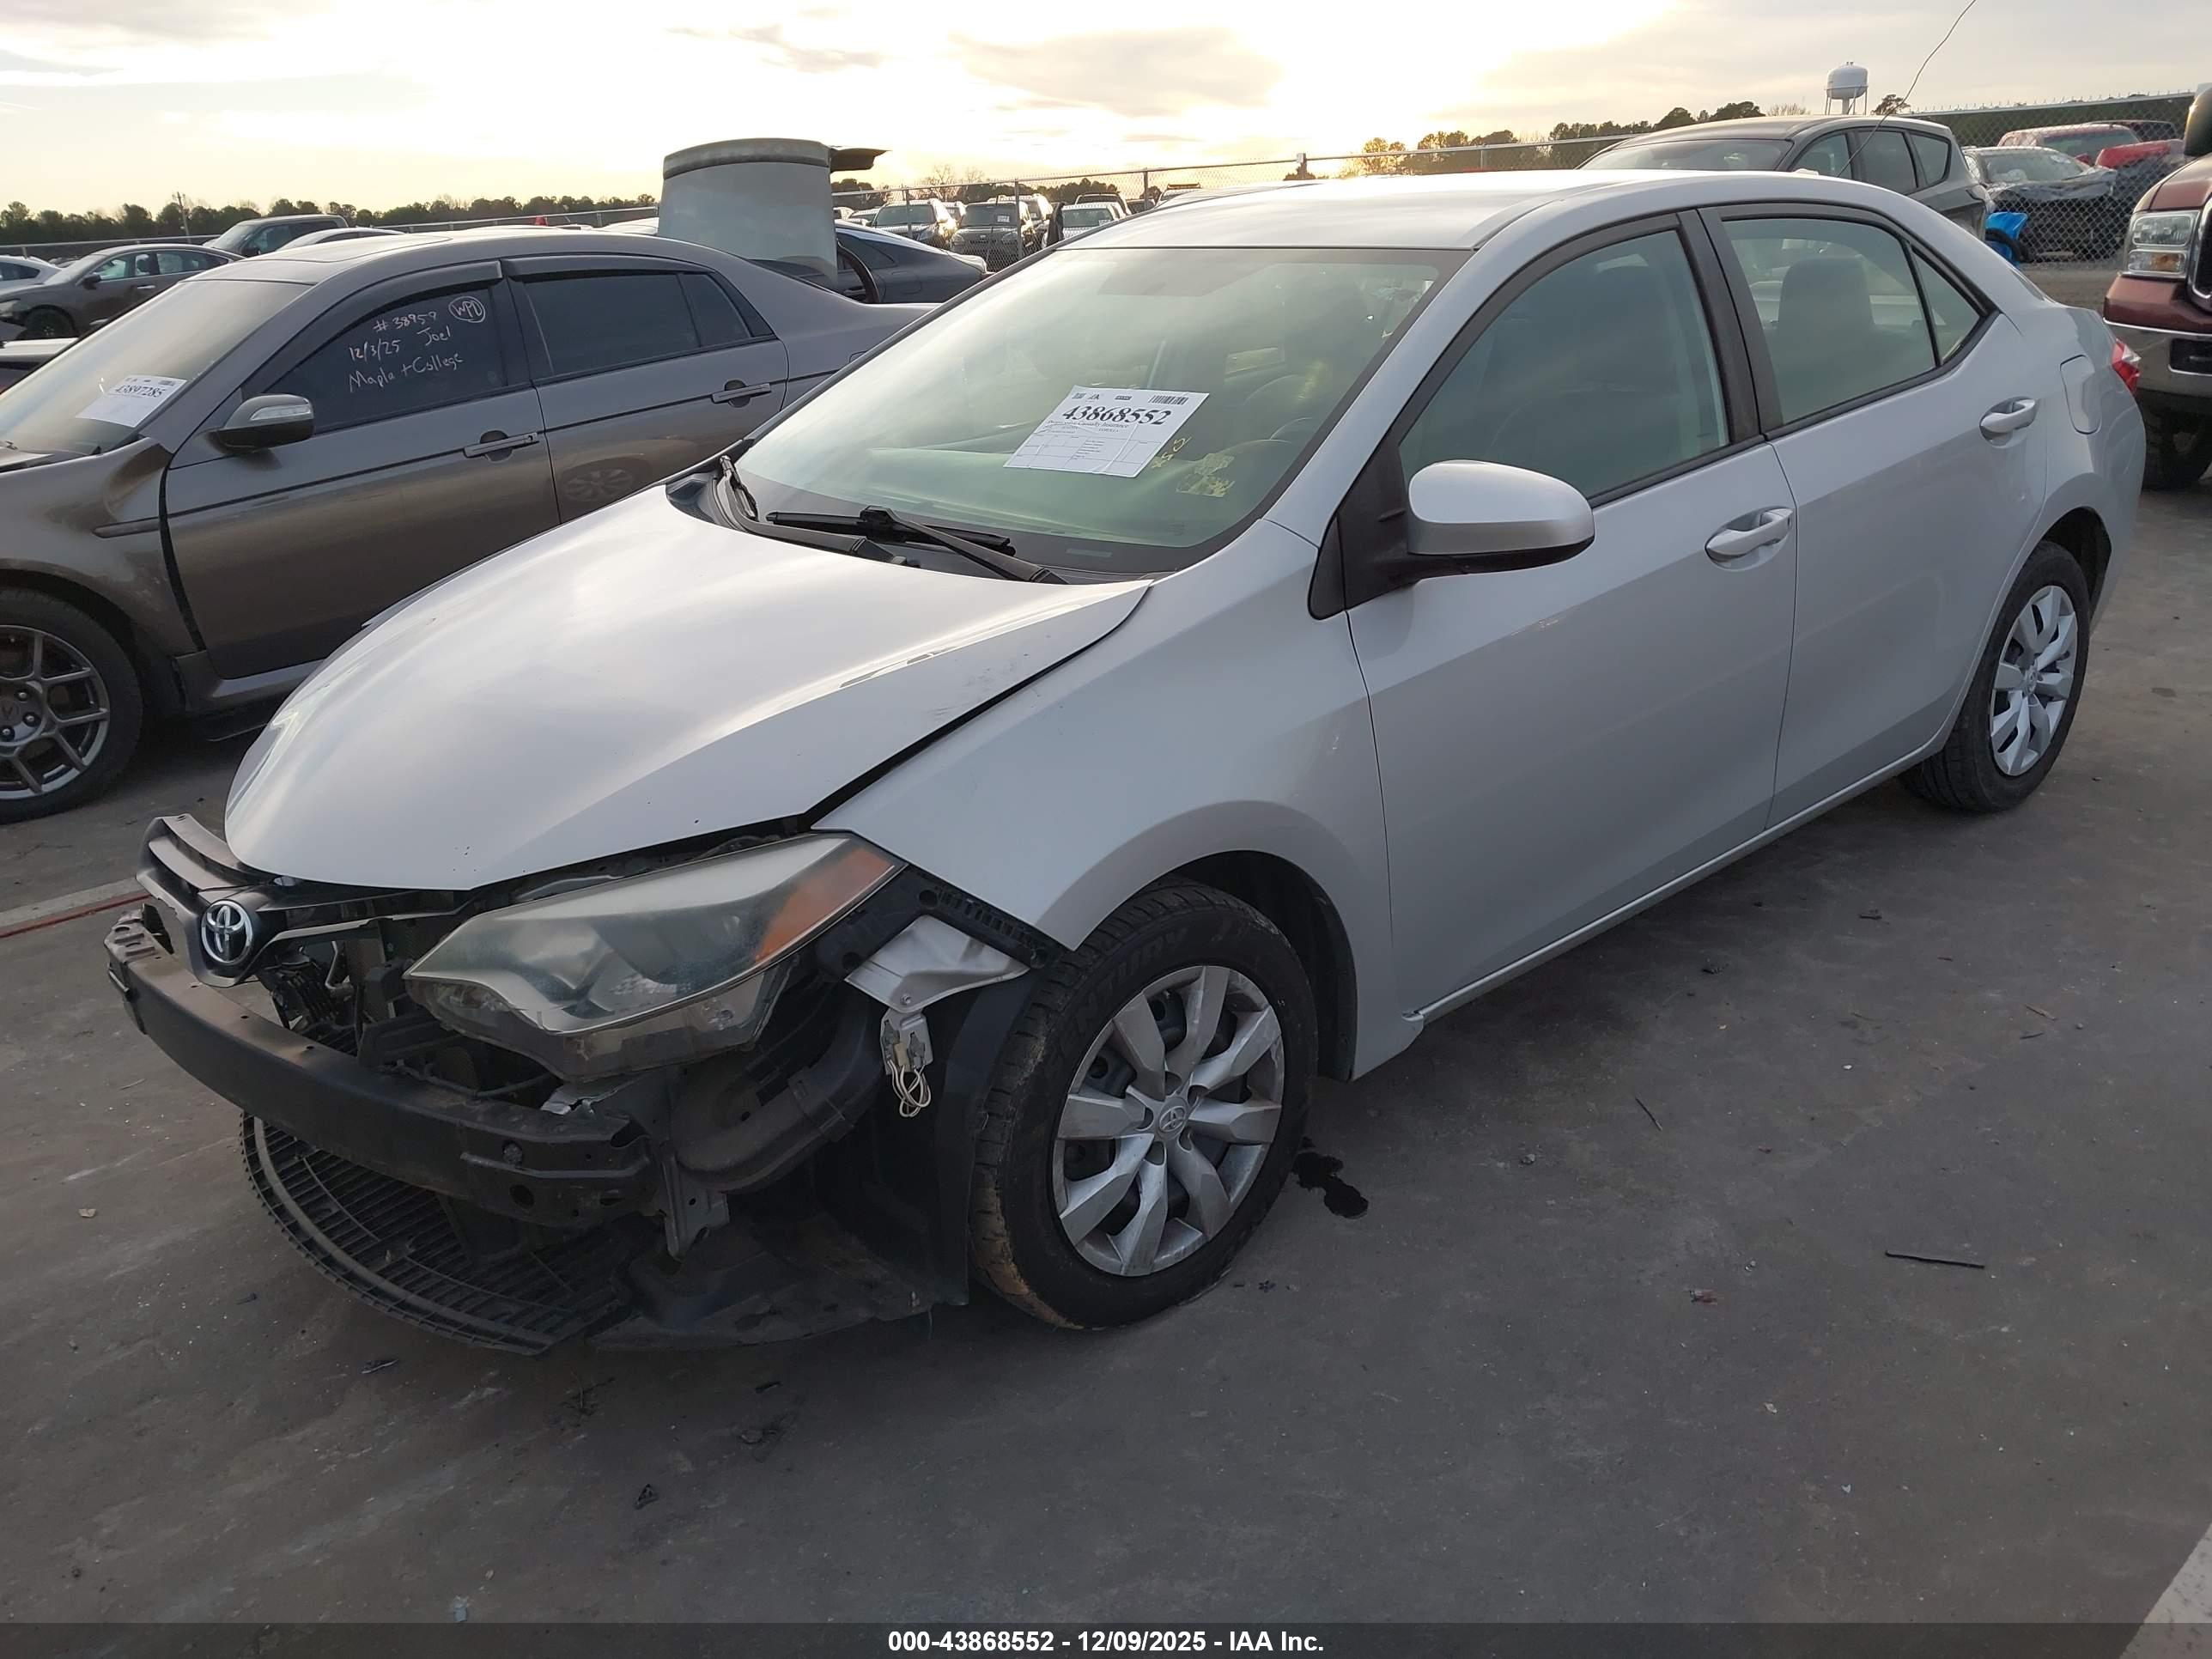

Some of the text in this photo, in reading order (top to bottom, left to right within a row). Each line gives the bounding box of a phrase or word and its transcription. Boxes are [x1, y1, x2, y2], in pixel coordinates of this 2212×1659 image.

[349, 325, 451, 362] 12/3/25 Joel
[1062, 405, 1171, 425] 43868552
